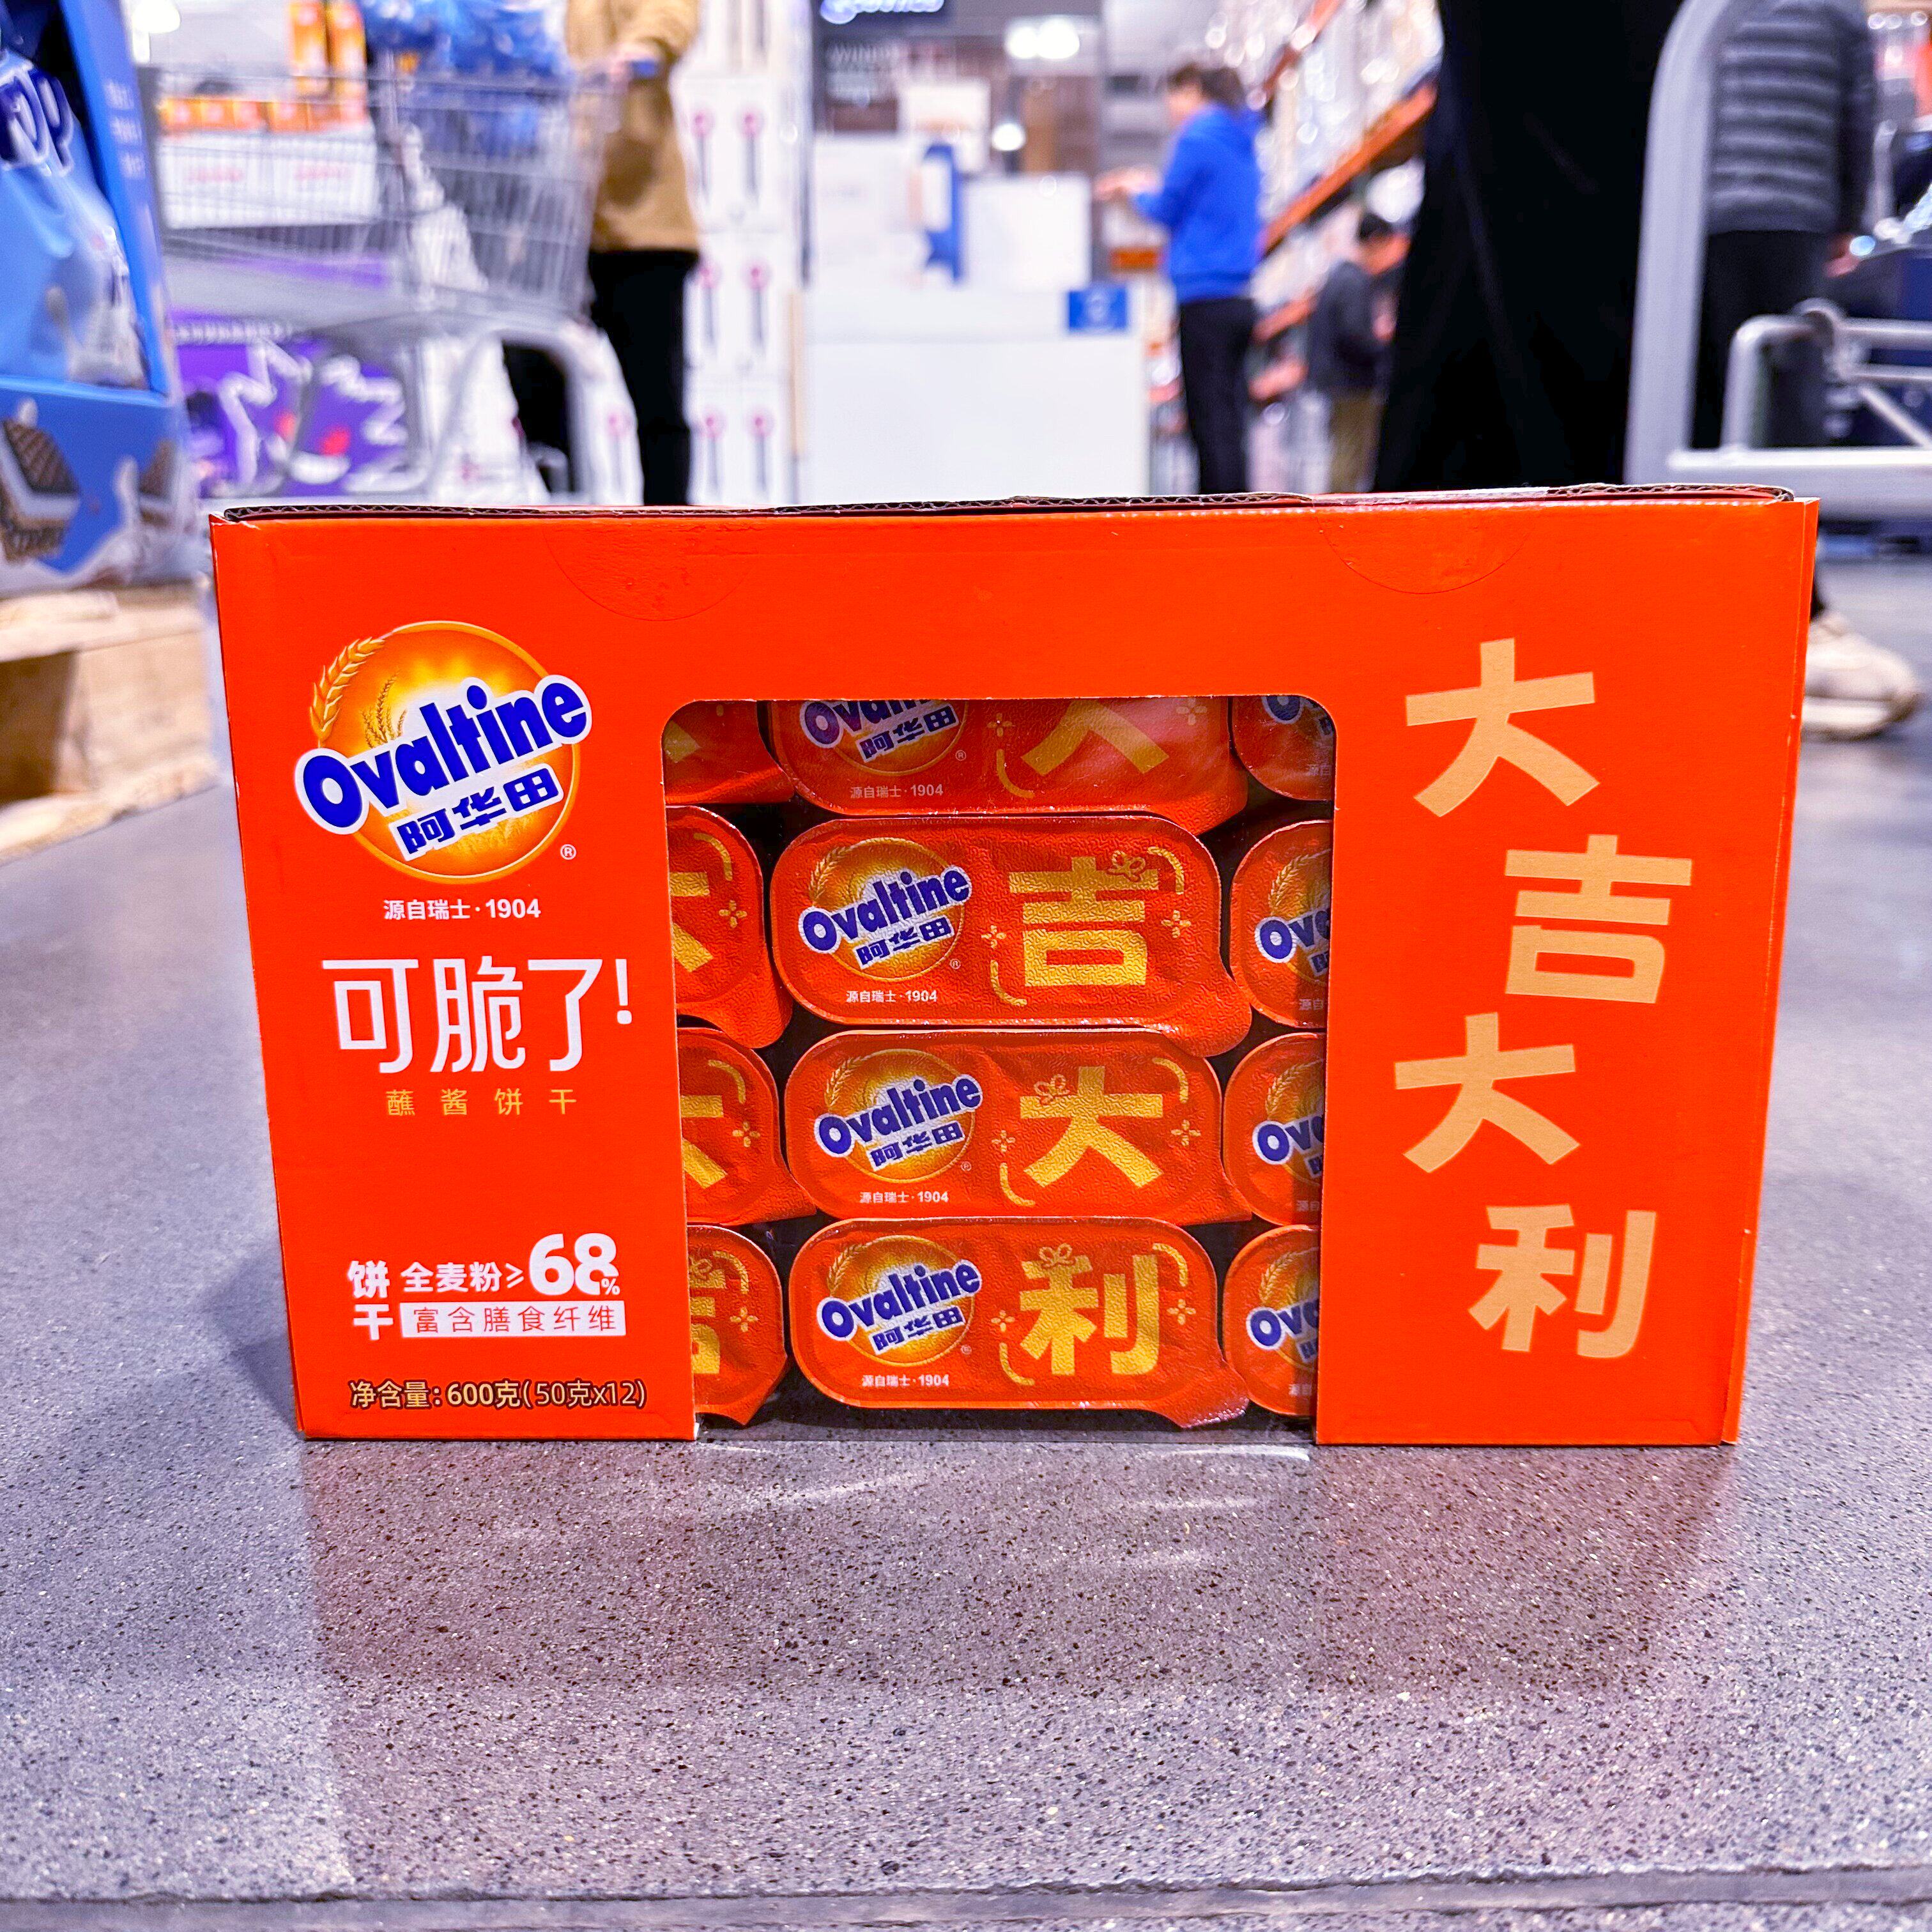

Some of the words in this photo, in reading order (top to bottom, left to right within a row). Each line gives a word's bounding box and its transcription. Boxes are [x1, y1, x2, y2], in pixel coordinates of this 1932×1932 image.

[302, 681, 589, 829] Ovaltine
[859, 705, 957, 759] 阿华田
[397, 769, 560, 855] 阿华田
[801, 869, 971, 952] Ovaltine
[856, 916, 953, 966] 阿华田
[1009, 857, 1158, 987] 吉
[1395, 638, 1692, 1359] 大吉大利
[386, 1088, 577, 1117] 蘸酱饼干
[818, 1078, 981, 1156] Ovaltine
[1020, 1066, 1164, 1188] 大
[870, 1121, 963, 1169] 阿华田
[347, 1260, 394, 1341] 饼干
[413, 1305, 617, 1333] 富含膳食纤维
[822, 1264, 981, 1337] Ovaltine
[873, 1308, 963, 1353] 阿华田
[1020, 1254, 1160, 1376] 利
